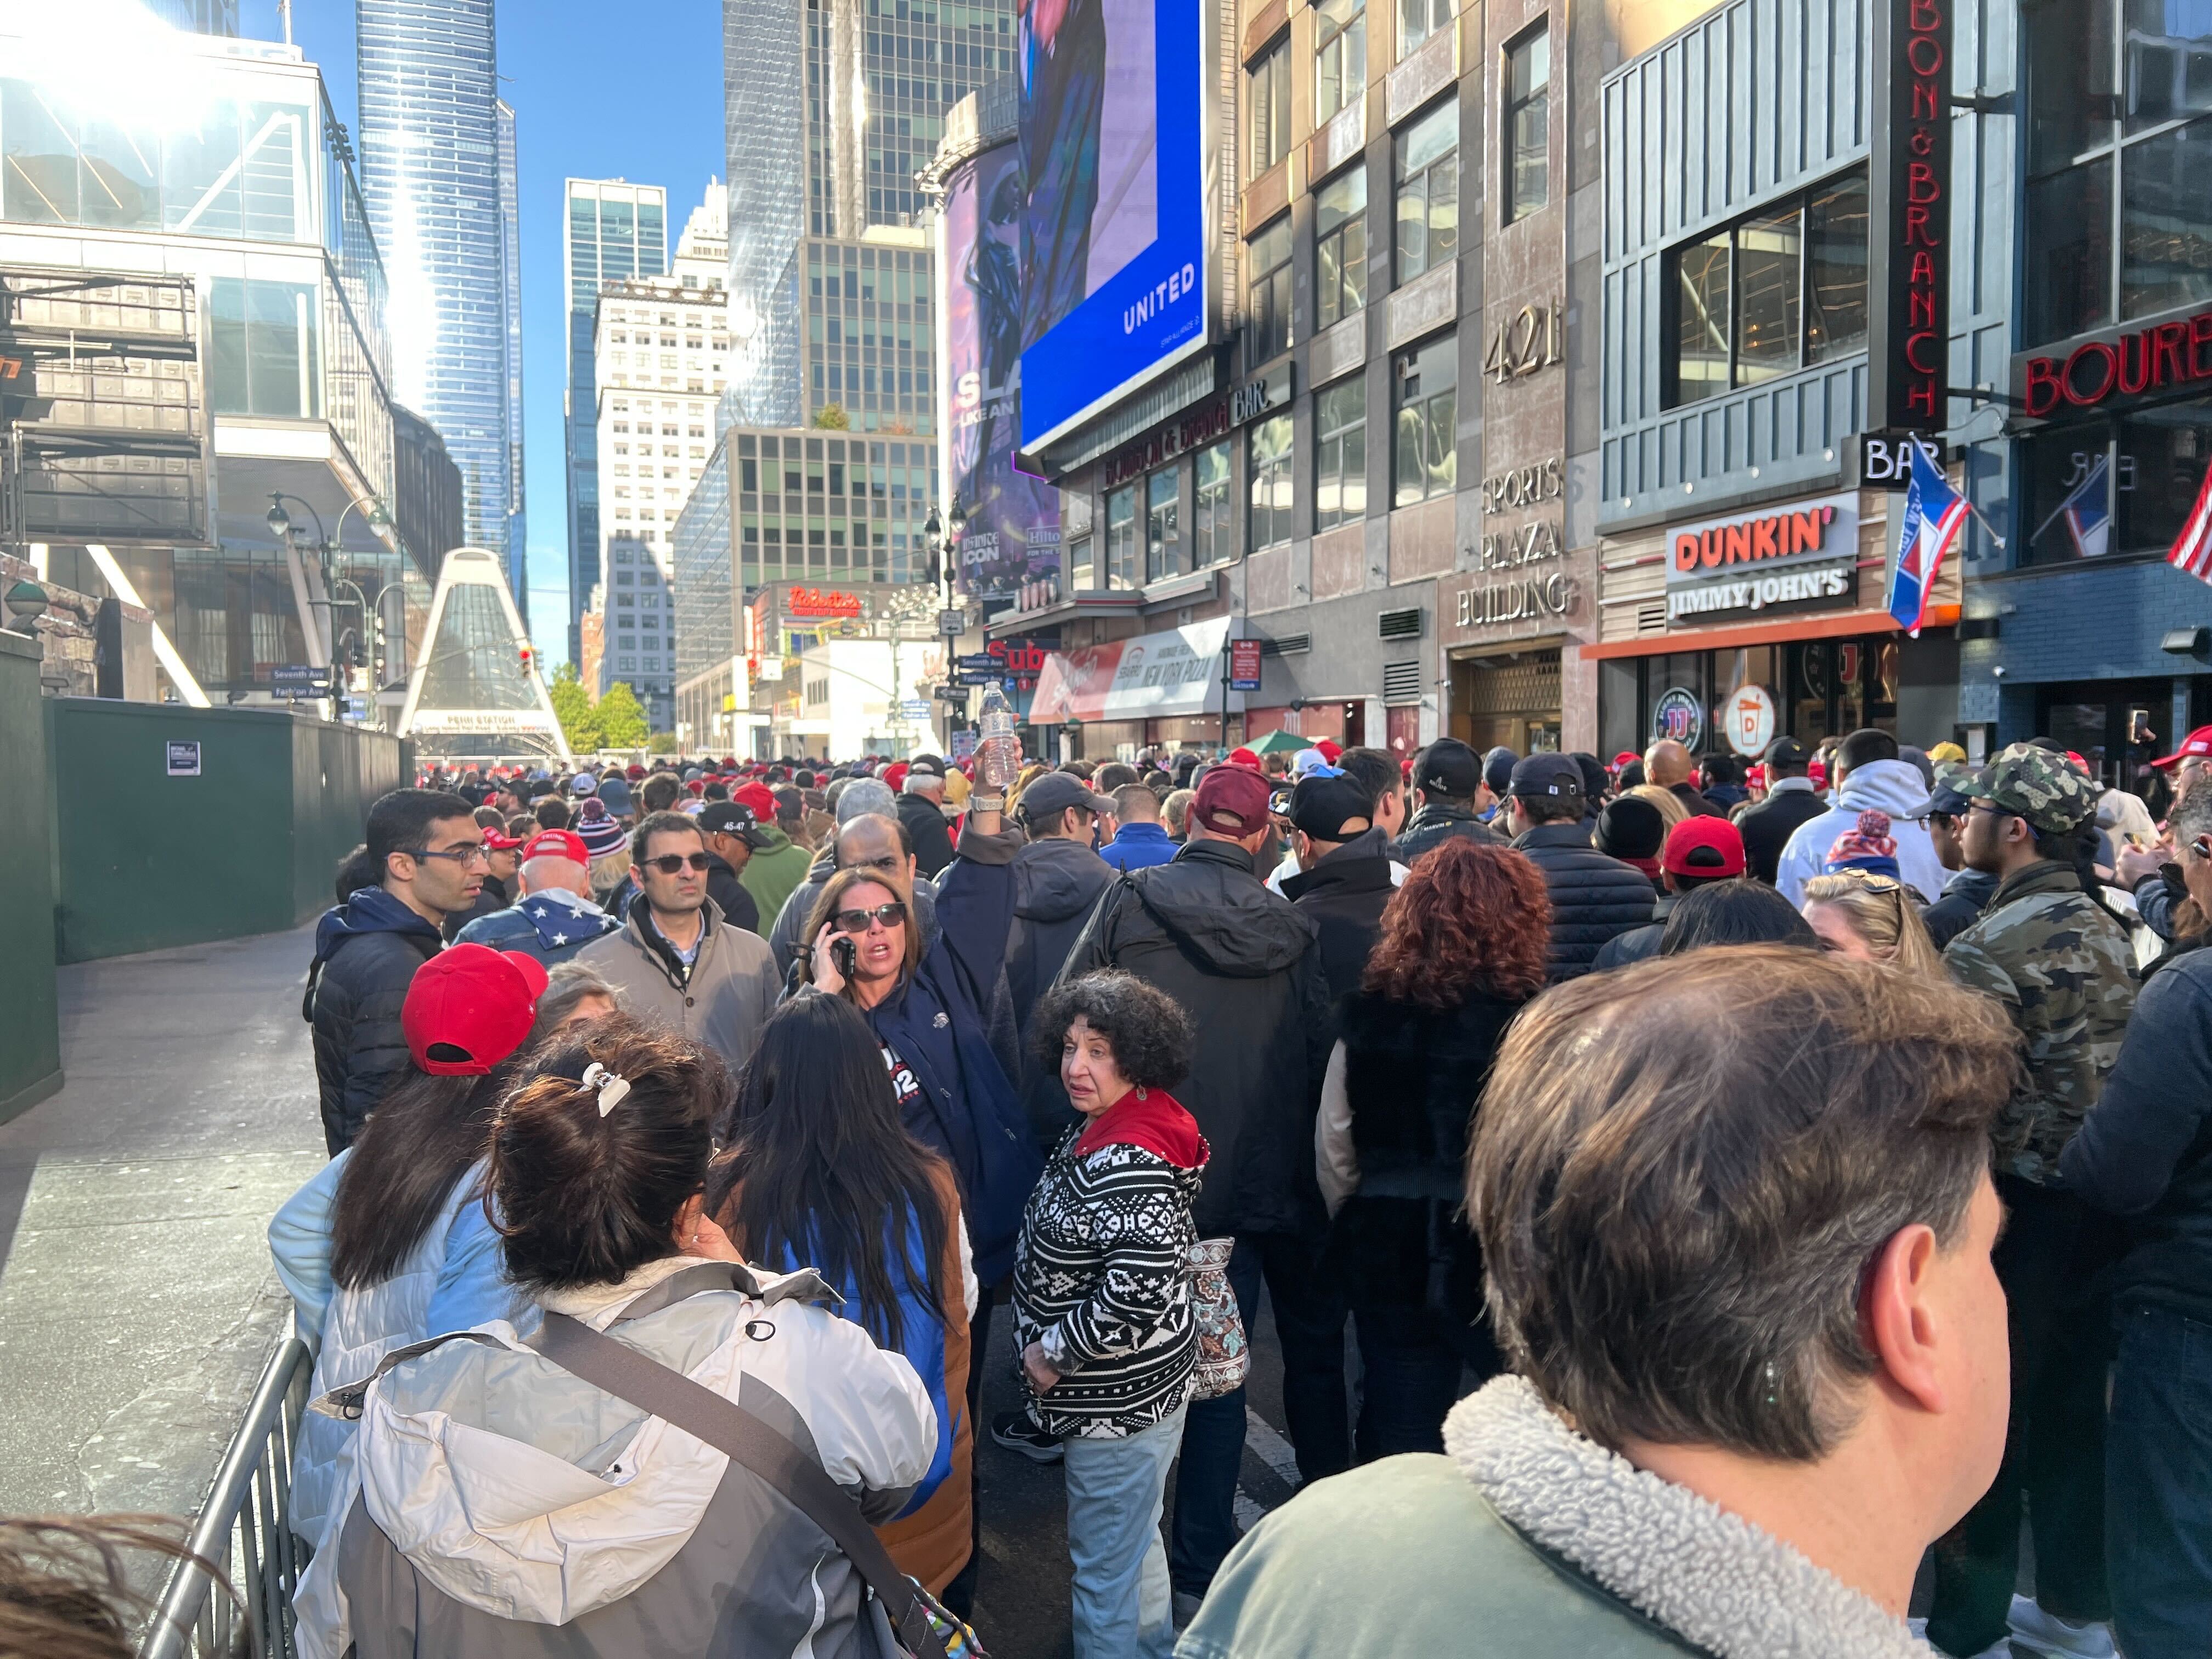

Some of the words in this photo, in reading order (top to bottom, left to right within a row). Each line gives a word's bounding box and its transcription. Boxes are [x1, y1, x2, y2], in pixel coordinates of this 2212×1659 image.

[1911, 127, 1937, 156] &
[1124, 263, 1194, 335] UNITED
[1906, 162, 1941, 417] BRANCH
[1483, 295, 1562, 385] 421
[960, 408, 988, 428] LIKE
[989, 401, 1014, 420] AN
[1234, 380, 1268, 422] BAR
[1481, 456, 1561, 515] SPORTS
[963, 532, 1000, 550] INFINITE
[1479, 518, 1561, 572] PLAZA
[1675, 506, 1833, 571] DUNKIN'
[963, 546, 1000, 566] ICON
[1456, 572, 1568, 627] BUILDING
[1667, 582, 1751, 620] JIMMY
[1748, 568, 1848, 610] JOHN'S
[989, 640, 1047, 670] Sub
[274, 670, 307, 679] Seventh
[309, 670, 324, 679] Ave
[1142, 664, 1164, 687] NEW
[1163, 661, 1186, 686] YORK
[1182, 656, 1211, 683] PIZZA
[309, 688, 324, 696] Ave
[1667, 708, 1688, 740] JJ
[1745, 717, 1754, 732] D
[724, 822, 744, 831] 45-47
